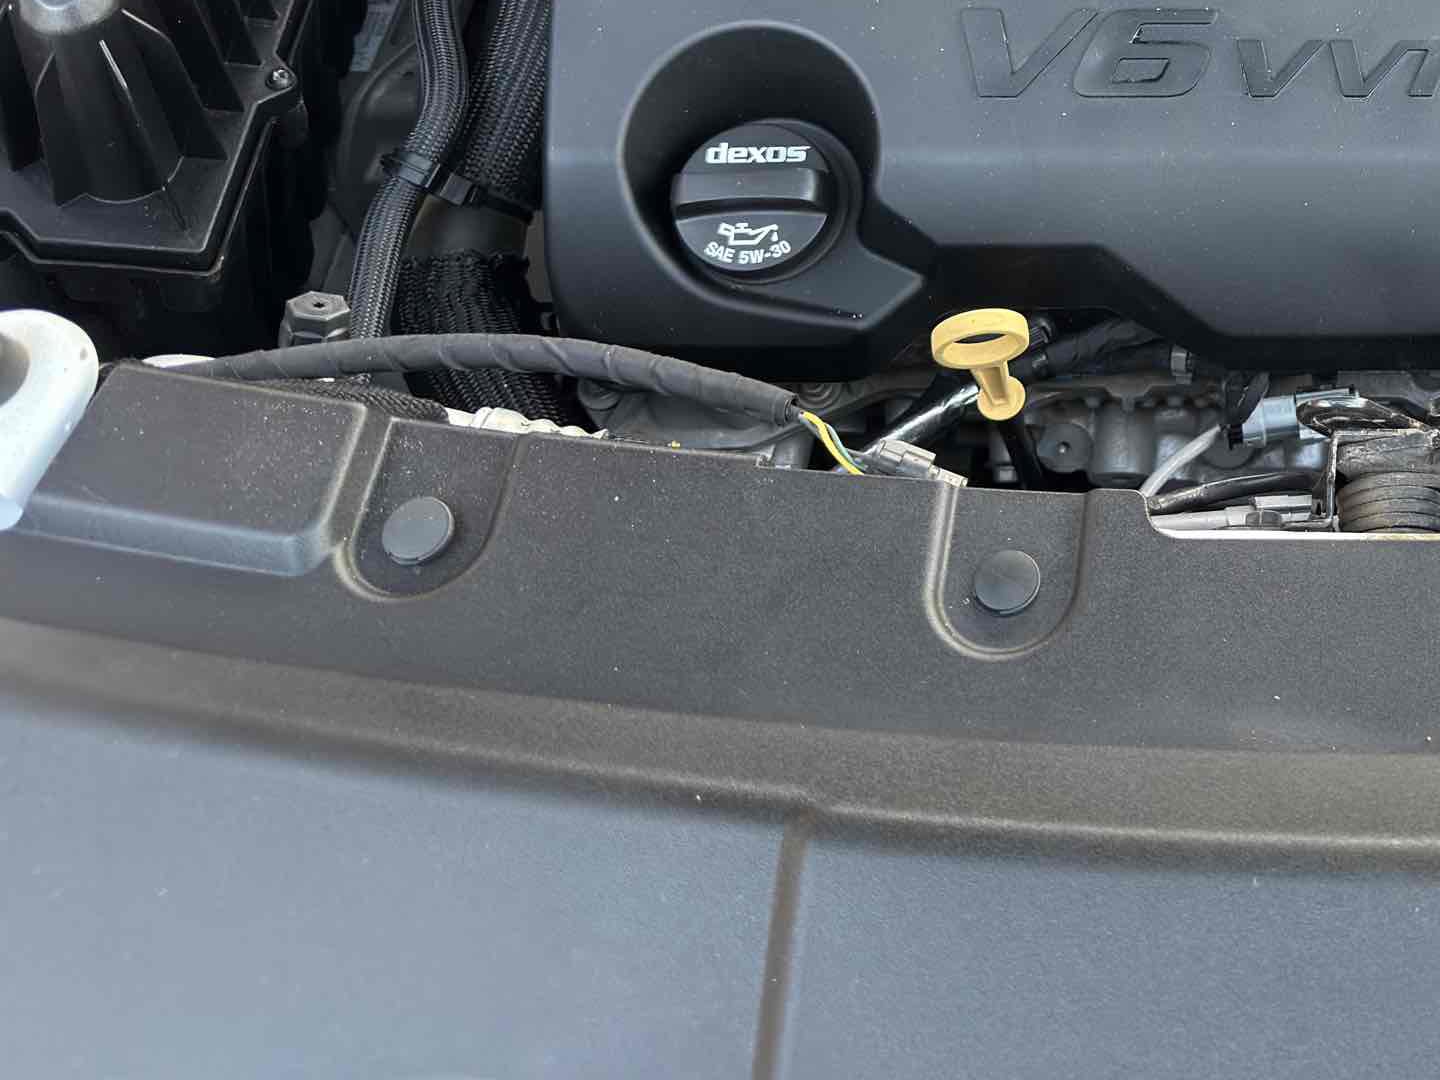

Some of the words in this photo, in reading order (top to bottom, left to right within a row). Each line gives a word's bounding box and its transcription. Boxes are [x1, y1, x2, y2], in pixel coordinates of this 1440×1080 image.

[960, 7, 1219, 98] V6
[705, 142, 811, 164] dexos
[703, 241, 736, 264] SAE
[738, 240, 792, 265] 5W-30
